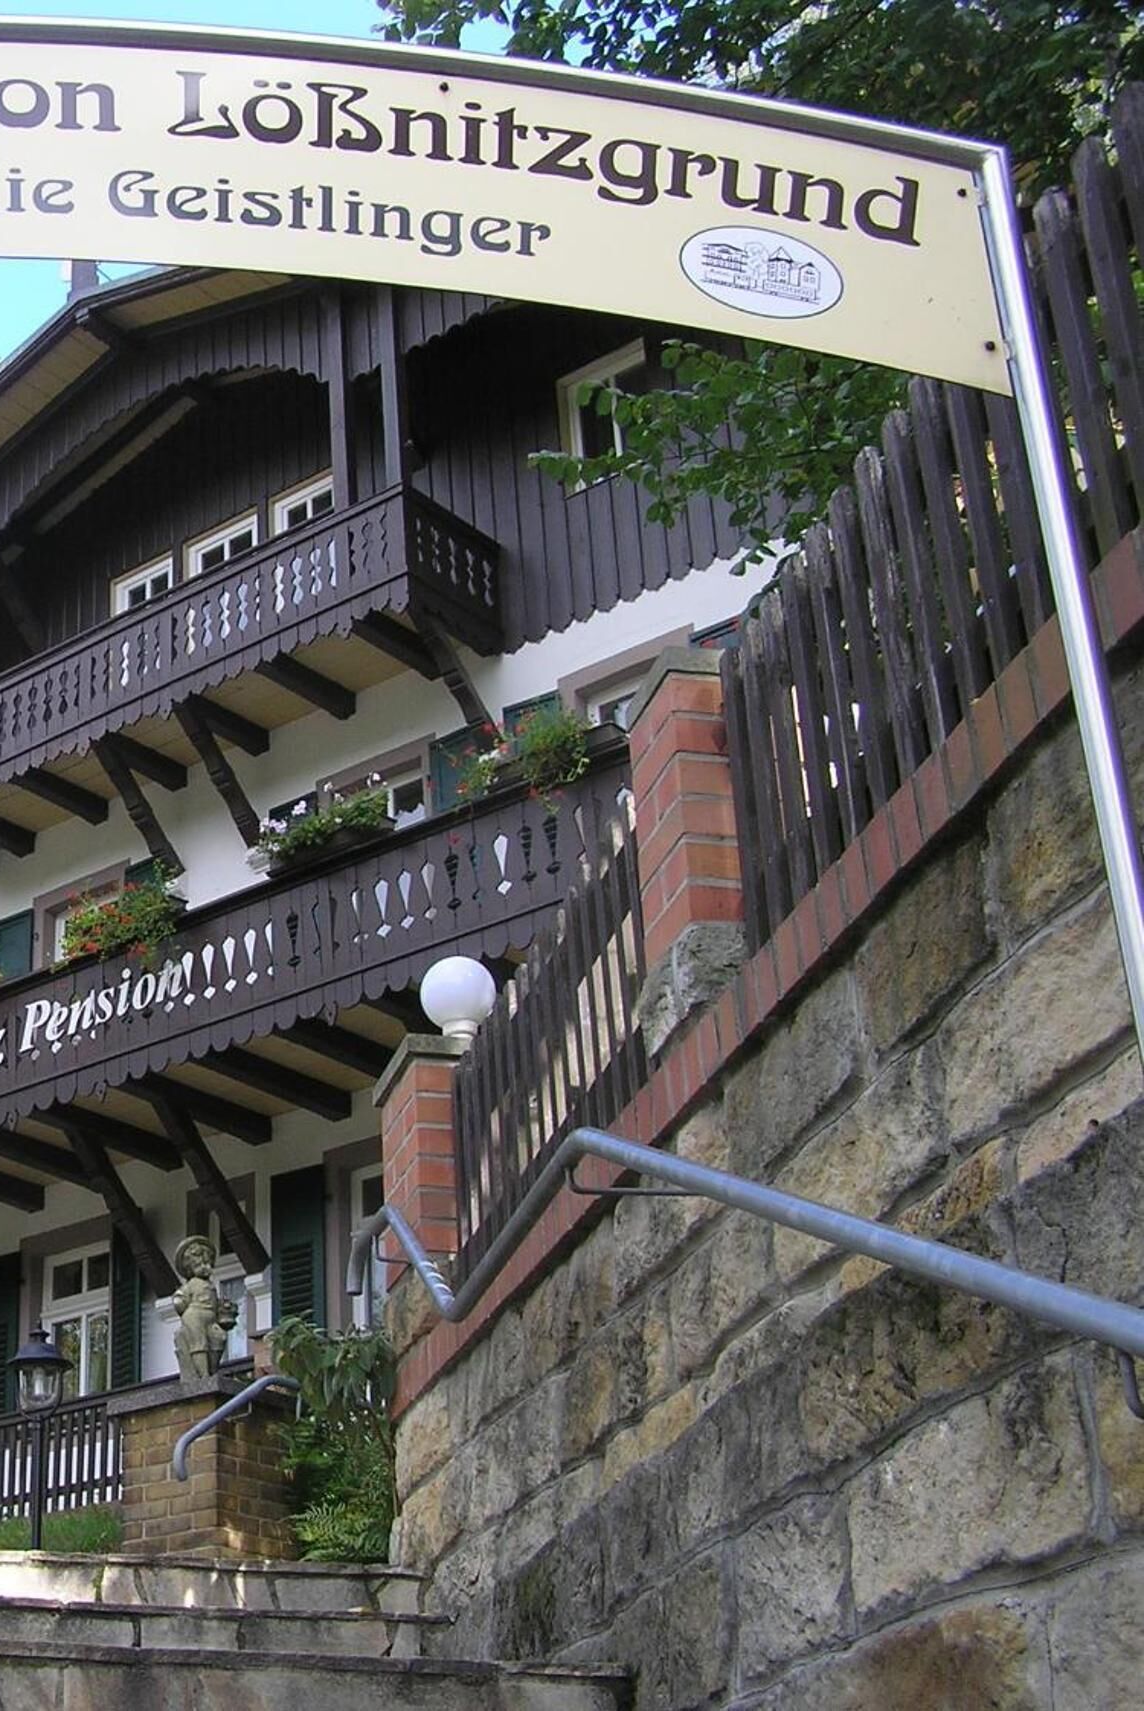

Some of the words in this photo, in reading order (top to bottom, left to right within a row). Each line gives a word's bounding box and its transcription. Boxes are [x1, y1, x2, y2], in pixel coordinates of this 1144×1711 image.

[167, 70, 922, 248] Lößnitzgrund
[108, 170, 553, 257] Geistlinger
[19, 962, 184, 1053] Pension
